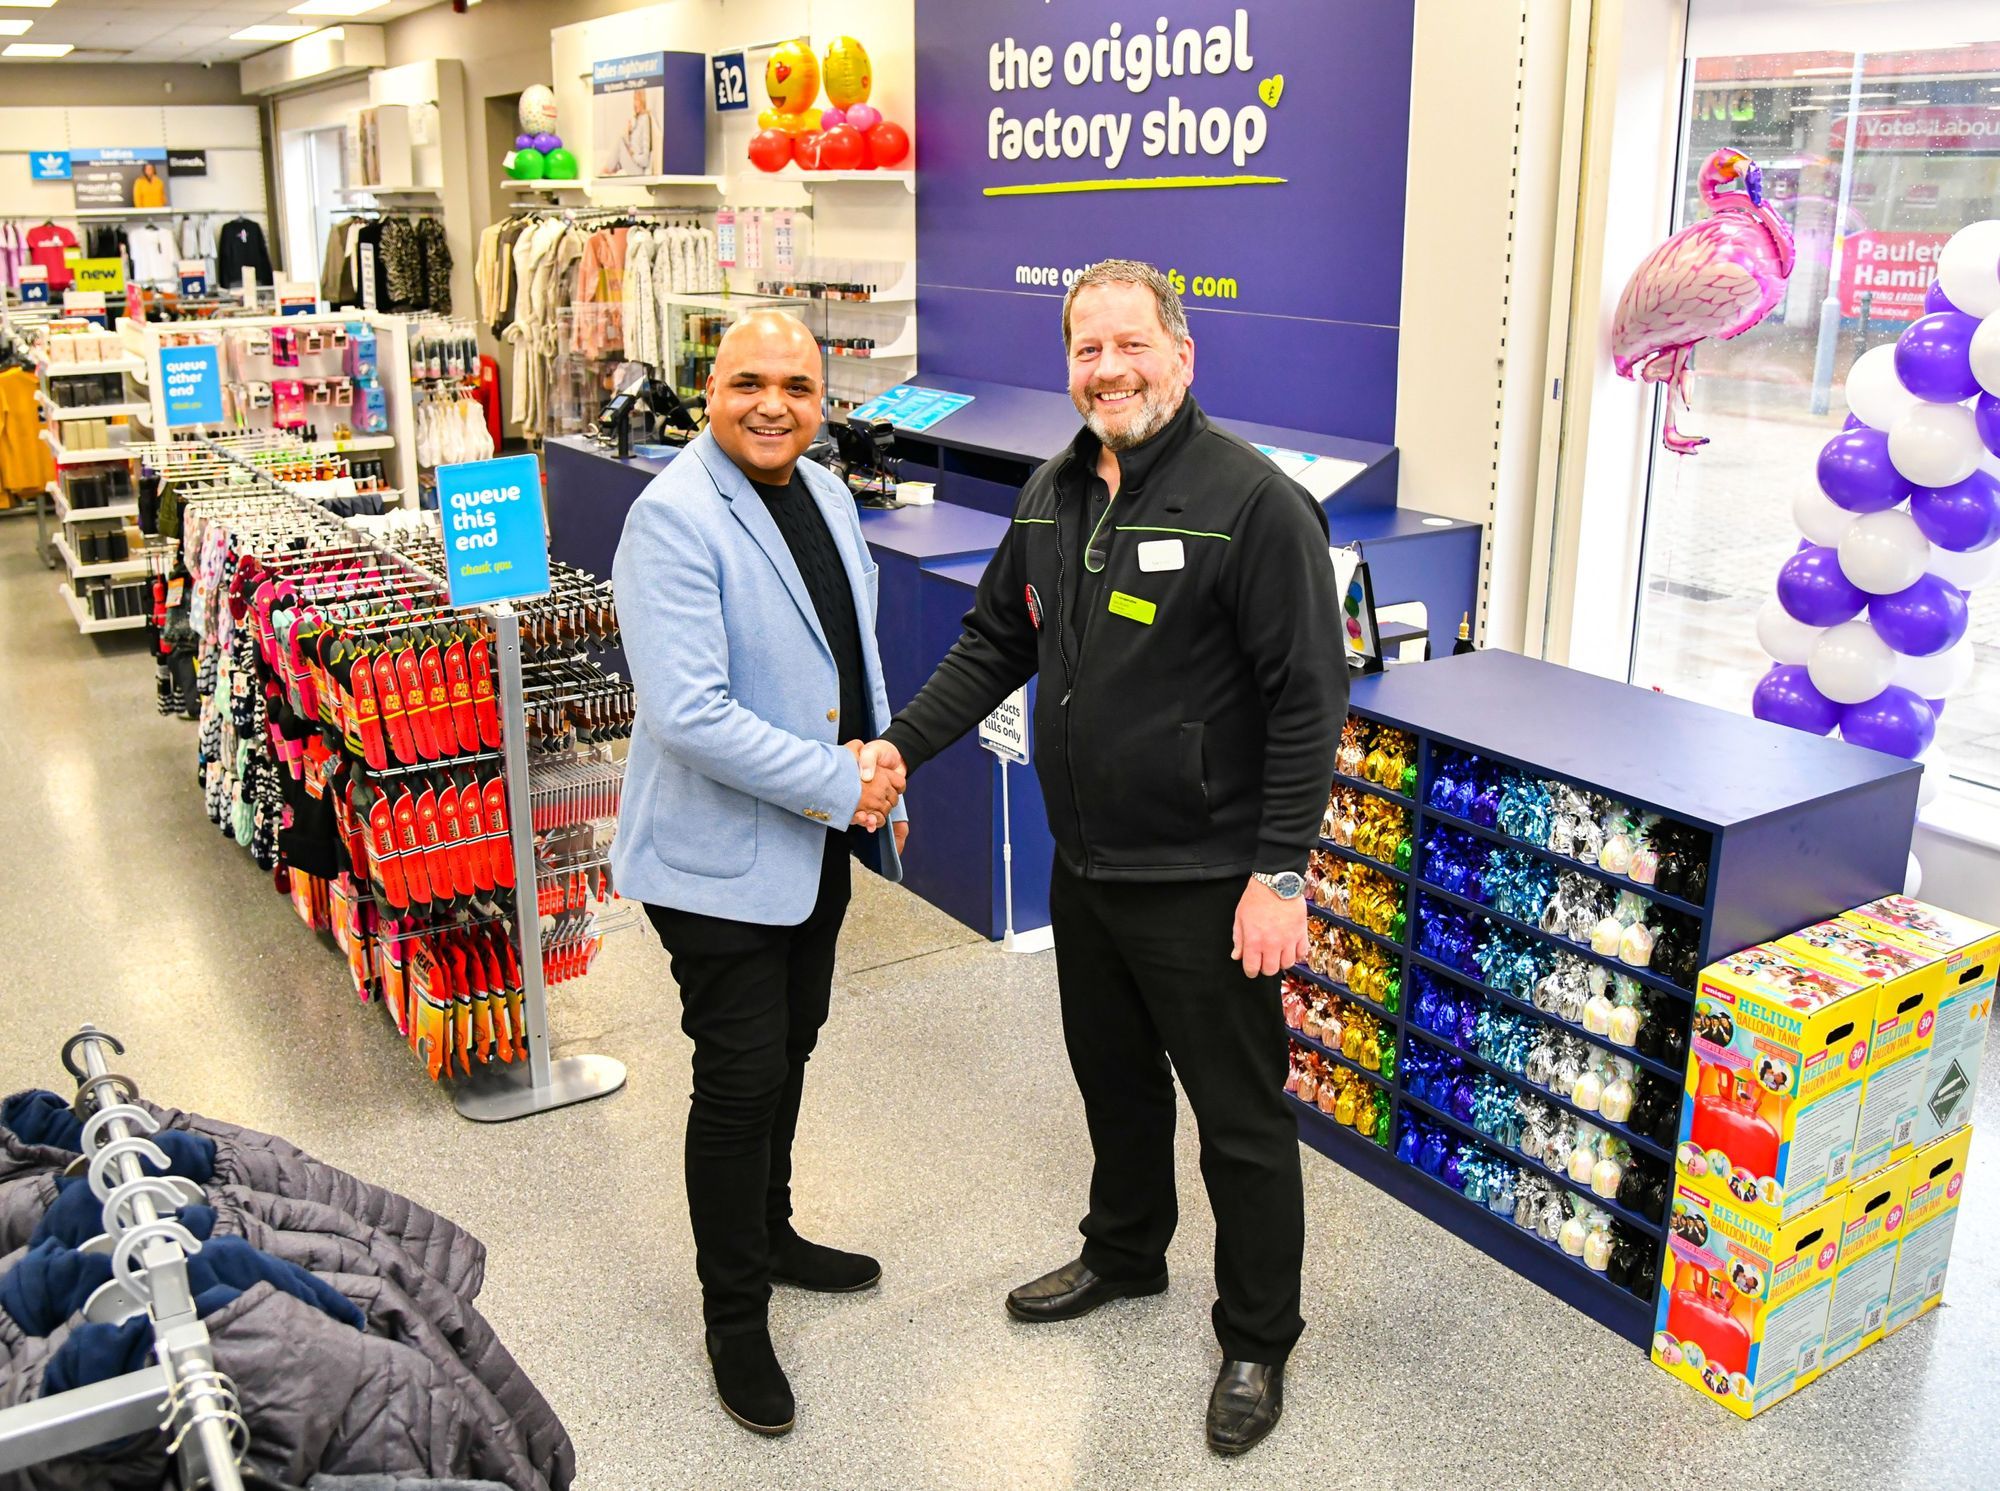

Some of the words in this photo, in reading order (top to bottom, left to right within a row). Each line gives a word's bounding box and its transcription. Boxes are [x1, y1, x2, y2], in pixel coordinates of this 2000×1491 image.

[989, 38, 1053, 91] the
[1064, 9, 1253, 92] original
[719, 65, 746, 104] £12
[988, 107, 1132, 169] factory
[1142, 96, 1267, 166] shop
[1866, 119, 1916, 136] Vote
[80, 270, 116, 280] new
[1016, 266, 1058, 286] more
[1192, 276, 1238, 298] com
[166, 360, 207, 373] queue
[168, 372, 202, 385] other
[169, 384, 194, 397] end
[450, 486, 520, 511] queue
[452, 509, 496, 530] this
[456, 528, 498, 551] end
[984, 719, 1002, 734] tills
[1003, 727, 1021, 744] only
[1000, 714, 1014, 726] our
[414, 950, 434, 974] HEAT
[1704, 986, 1732, 1000] unique
[1738, 998, 1803, 1036] HELIUM
[1736, 1012, 1777, 1042] BALLOON
[1778, 1029, 1800, 1050] TANK
[1876, 1021, 1914, 1048] HELIUM
[1851, 1047, 1862, 1062] 30
[1803, 1052, 1844, 1083] HELIUM
[1682, 1187, 1706, 1204] unique
[1713, 1204, 1774, 1244] HELIUM
[1844, 1216, 1882, 1246] HELIUM
[1710, 1216, 1748, 1246] BALLOON
[1750, 1234, 1772, 1258] TANK
[1820, 1248, 1832, 1262] 30
[1773, 1256, 1814, 1286] HELIUM
